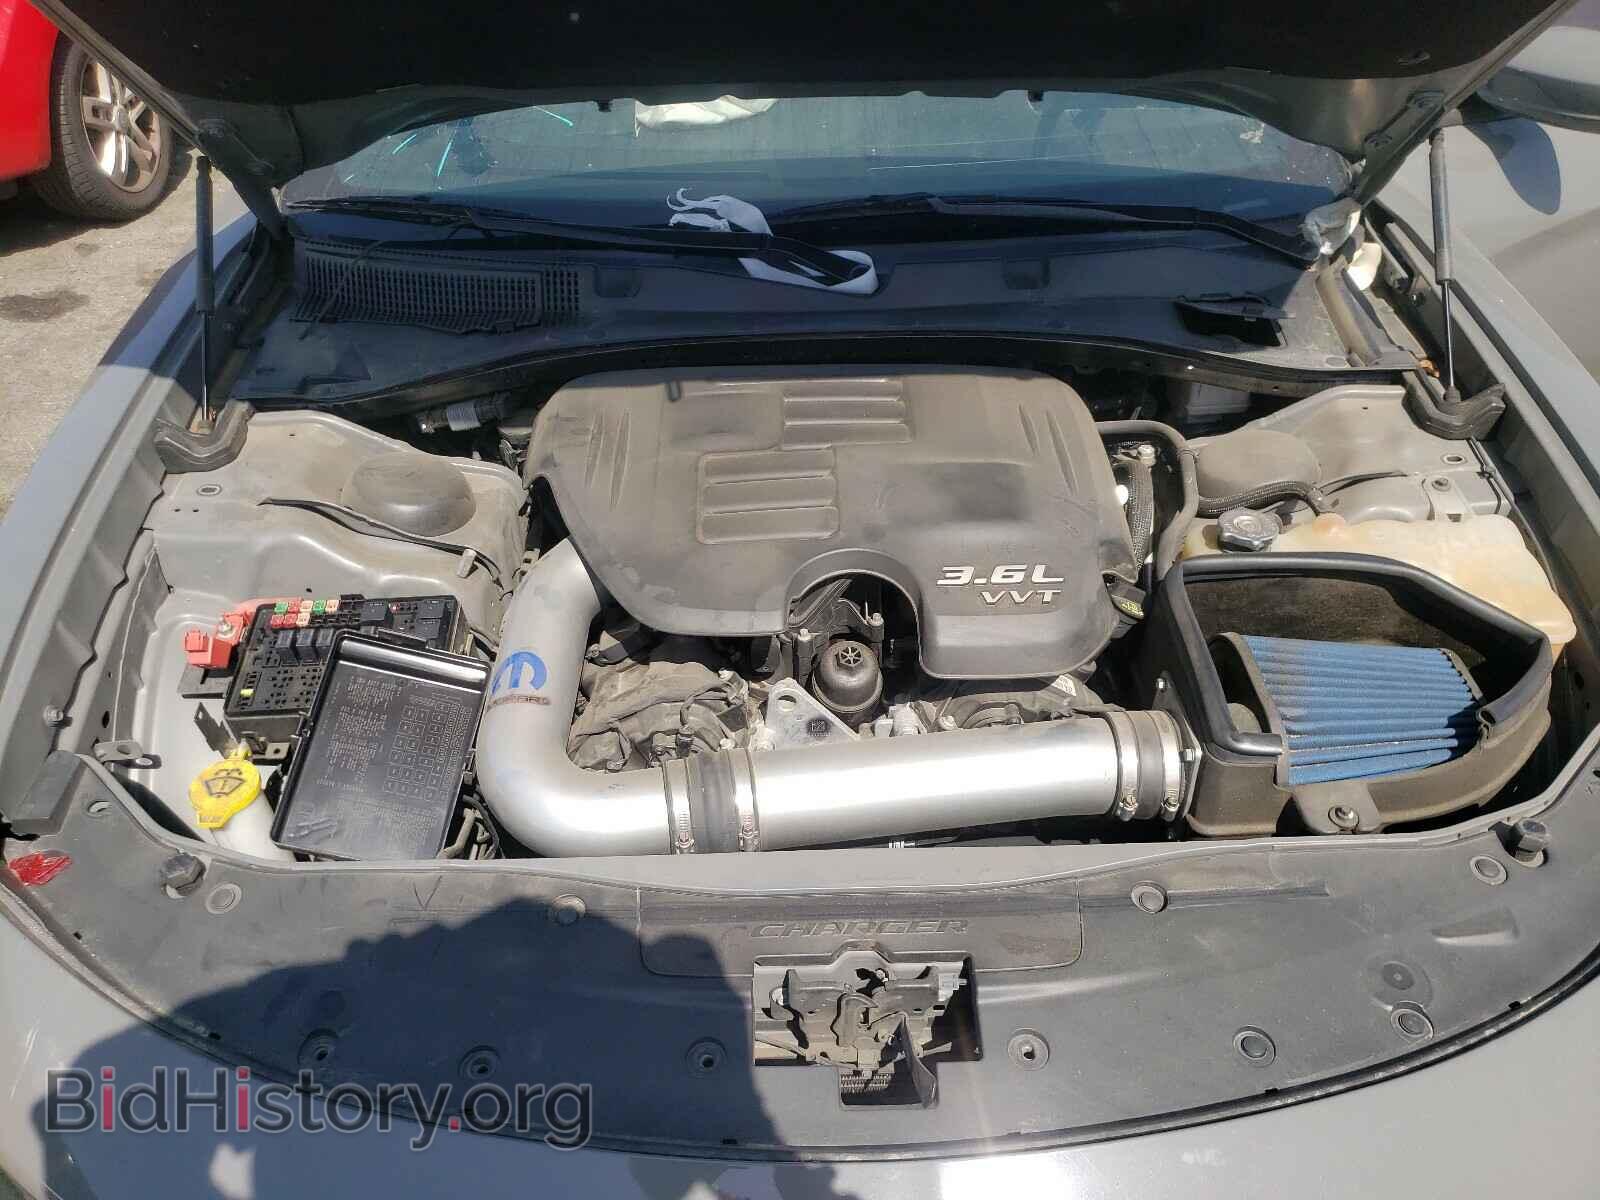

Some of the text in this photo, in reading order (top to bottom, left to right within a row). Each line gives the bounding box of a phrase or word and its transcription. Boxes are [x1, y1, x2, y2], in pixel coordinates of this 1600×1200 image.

[937, 564, 1064, 586] 3.6L
[981, 589, 1062, 606] VVT
[750, 919, 969, 937] CHARGER
